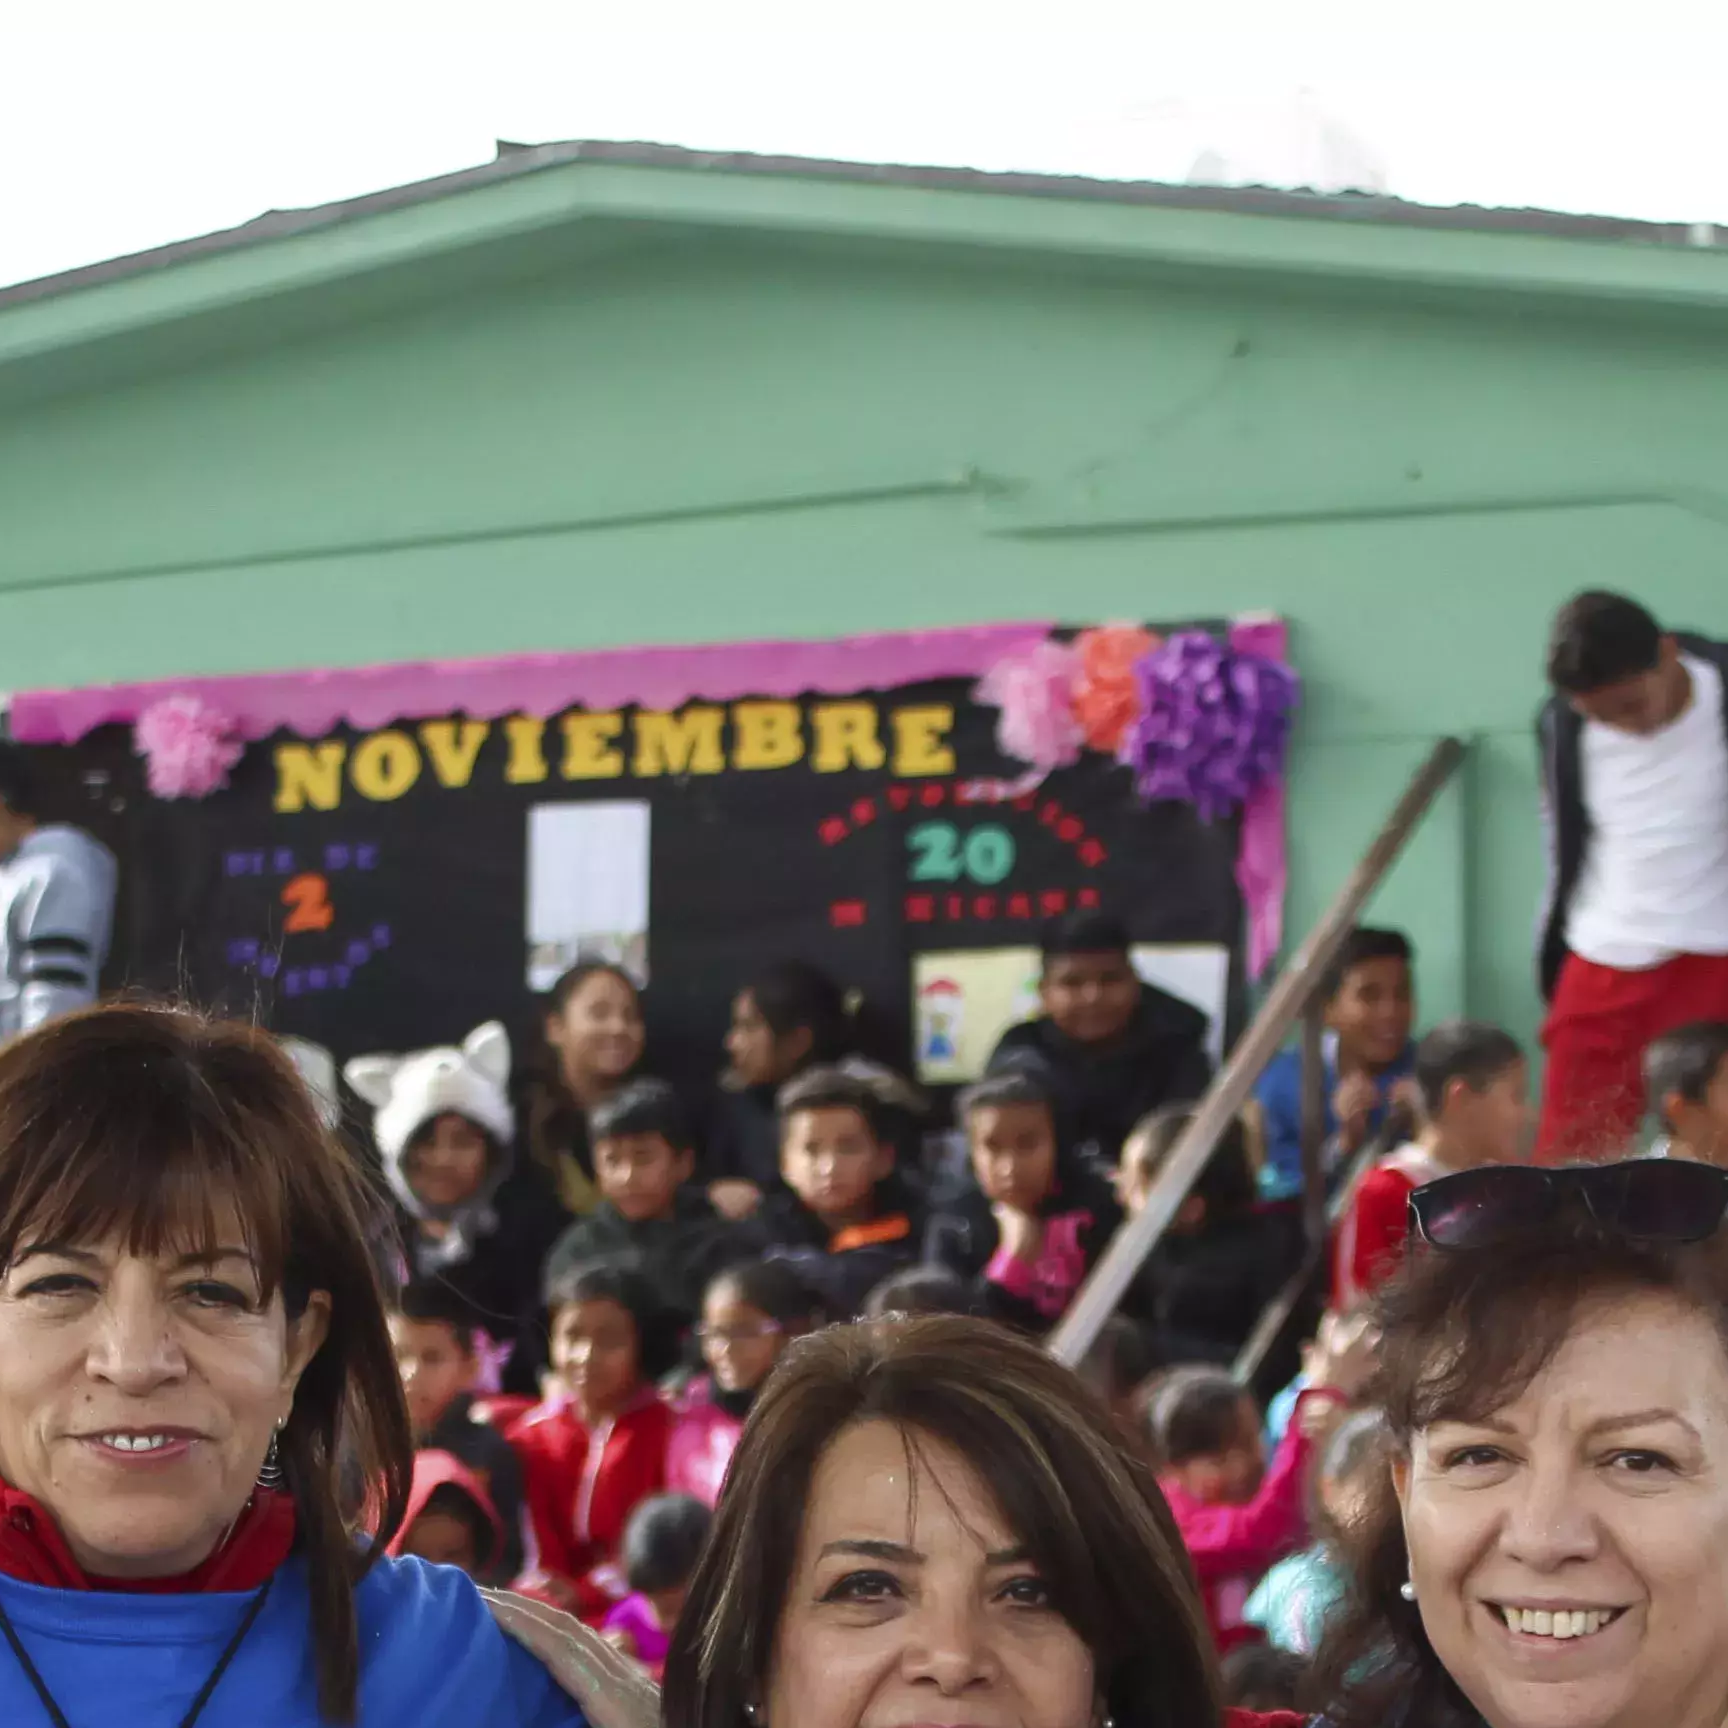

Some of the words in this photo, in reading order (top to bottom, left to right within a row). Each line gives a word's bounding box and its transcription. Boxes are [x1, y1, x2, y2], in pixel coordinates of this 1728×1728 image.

[272, 701, 958, 814] NOVIEMBRE
[906, 818, 1017, 886] 20
[280, 870, 335, 935] 2
